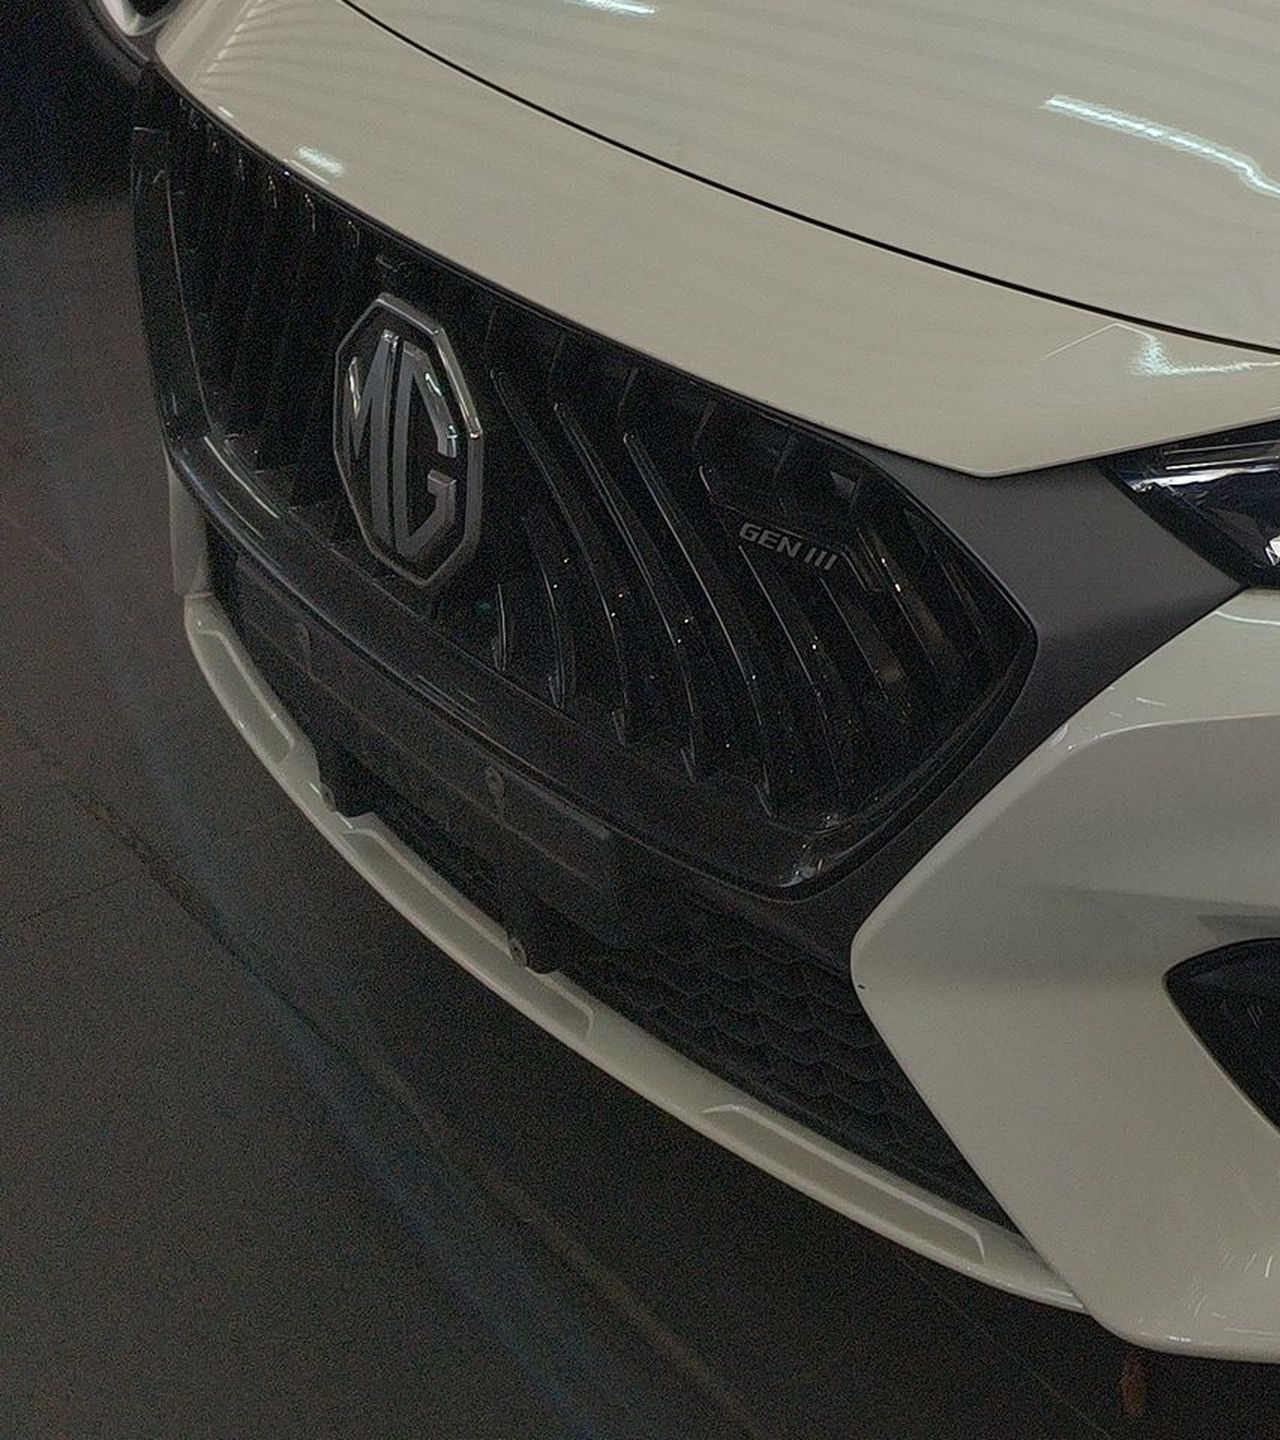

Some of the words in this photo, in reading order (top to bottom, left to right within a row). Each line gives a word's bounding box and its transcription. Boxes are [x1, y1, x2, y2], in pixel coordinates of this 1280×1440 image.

[342, 328, 457, 558] MG
[739, 522, 802, 558] GEN
[804, 547, 838, 571] III
